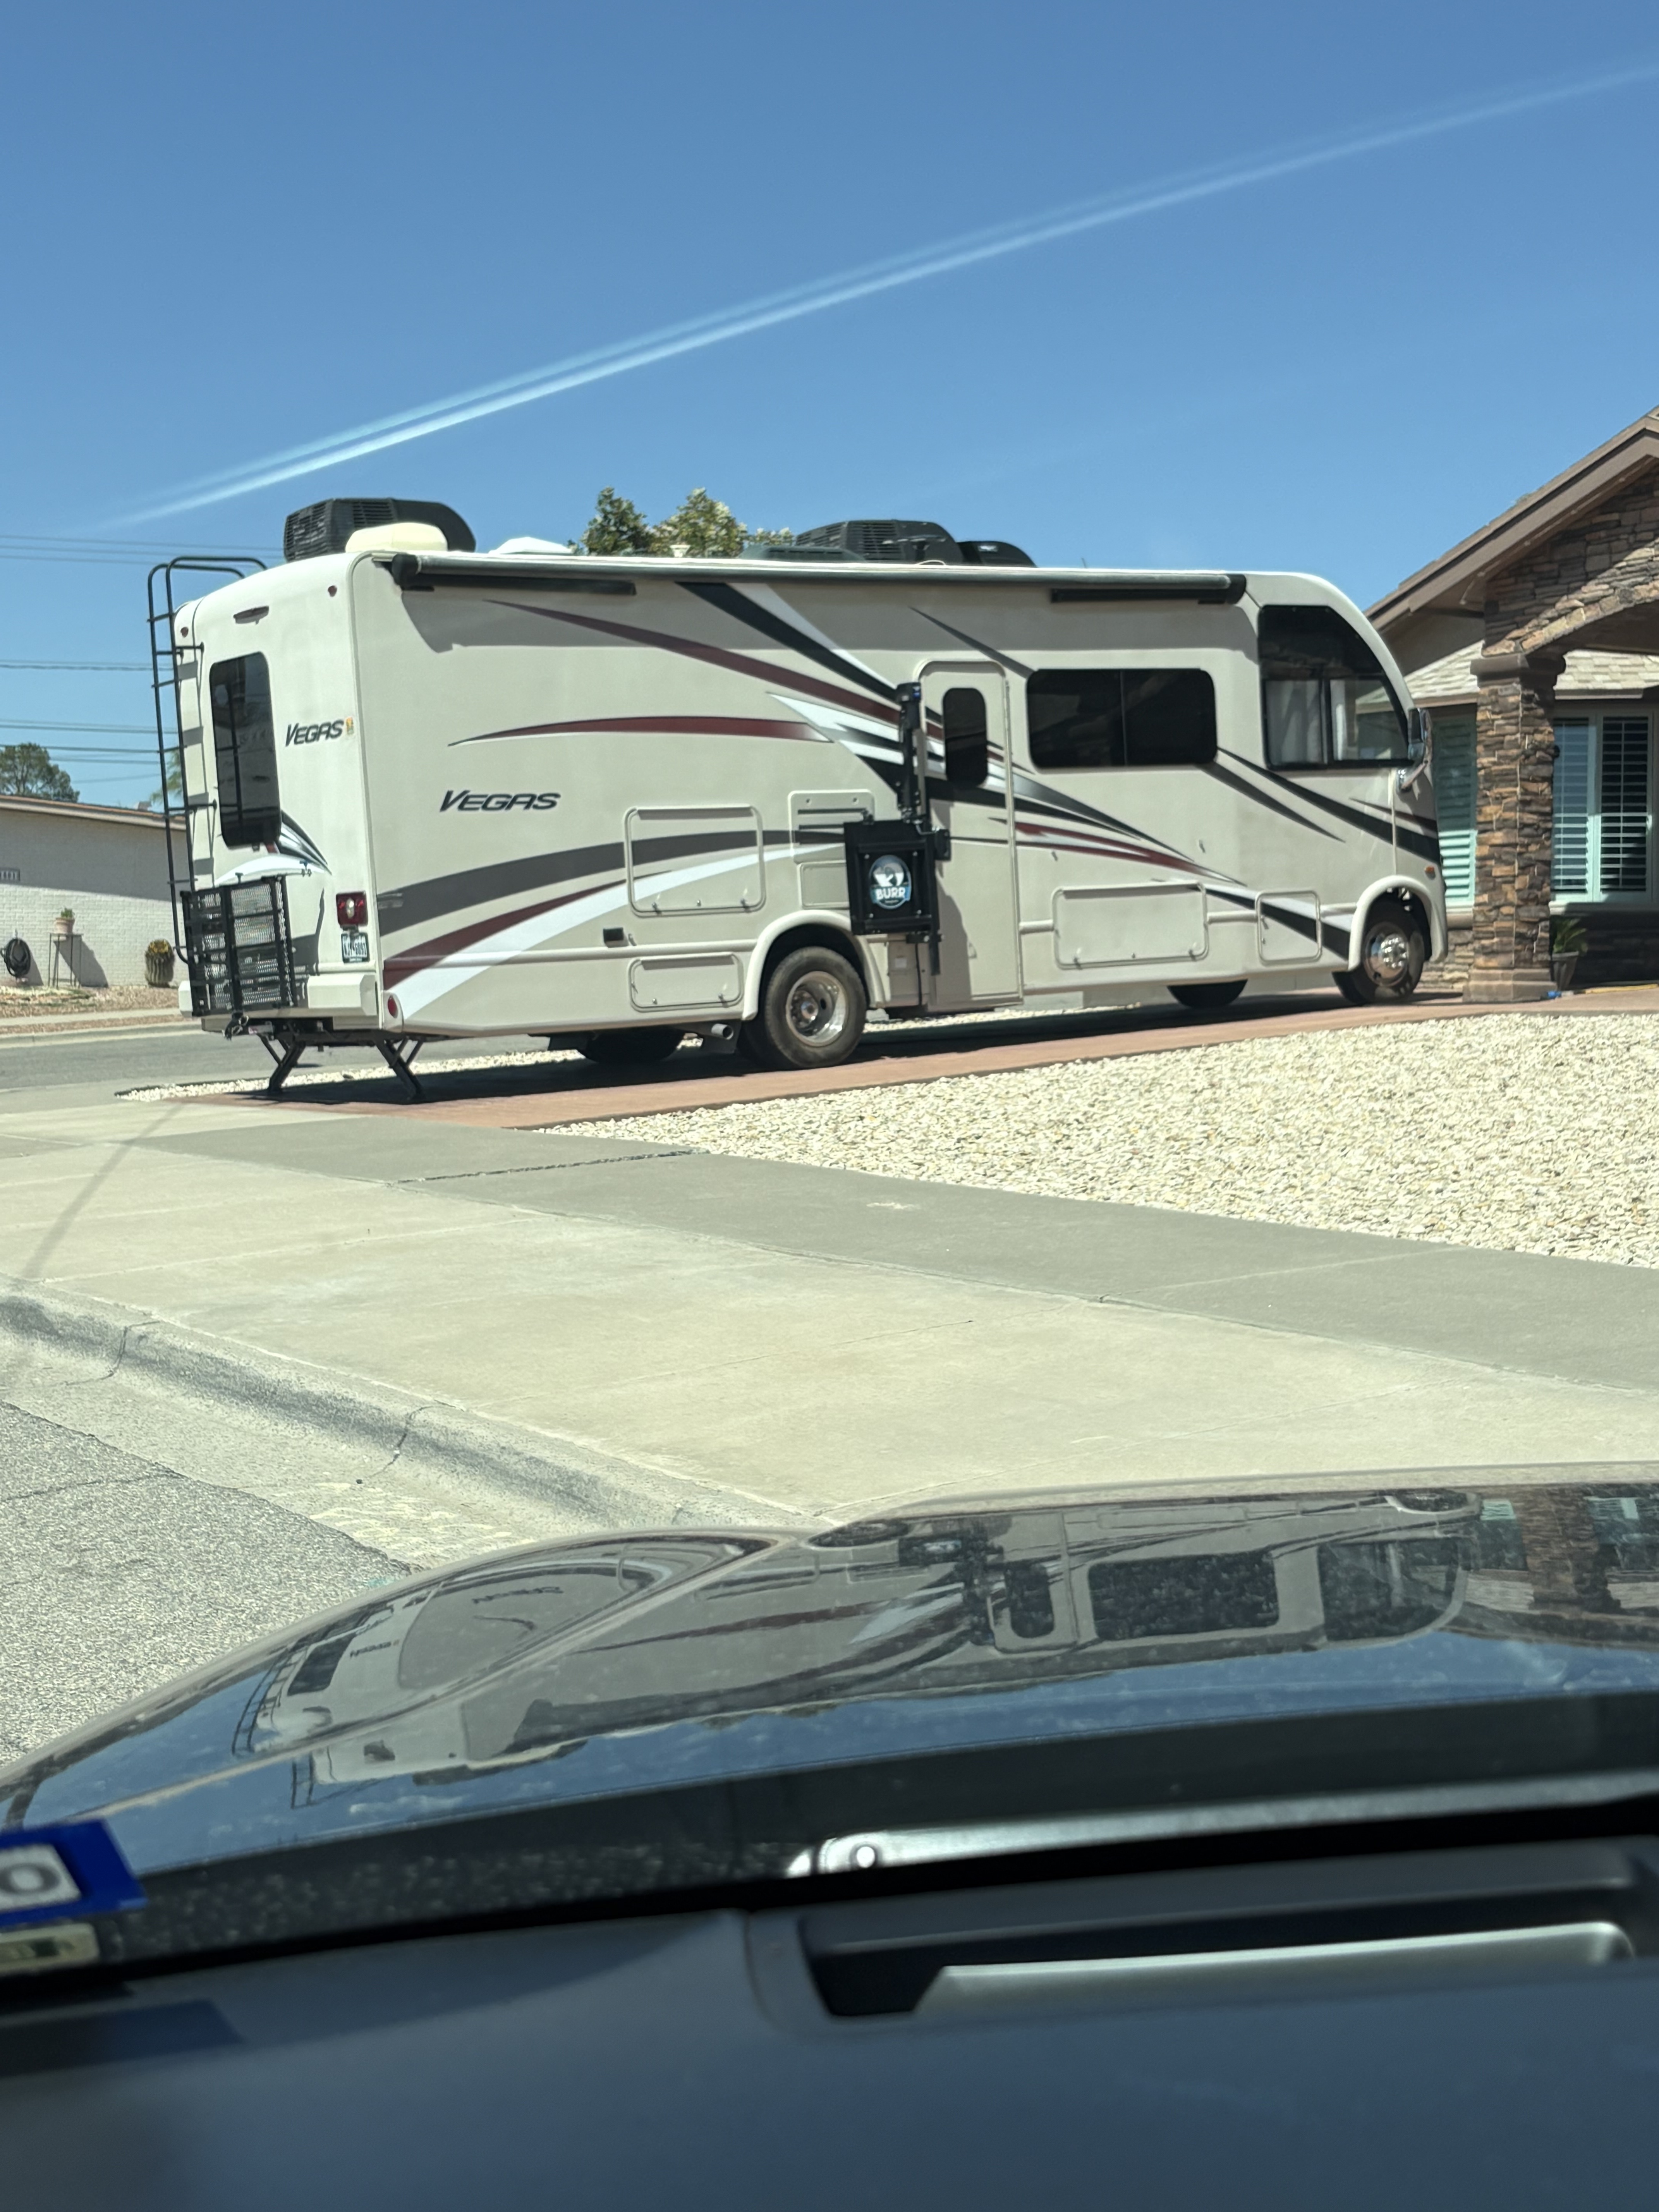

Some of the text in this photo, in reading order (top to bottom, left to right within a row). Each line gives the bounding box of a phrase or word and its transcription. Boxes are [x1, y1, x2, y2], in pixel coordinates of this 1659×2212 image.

[285, 719, 344, 747] VEGAS
[440, 790, 561, 812] VEGAS
[876, 887, 906, 900] BURR
